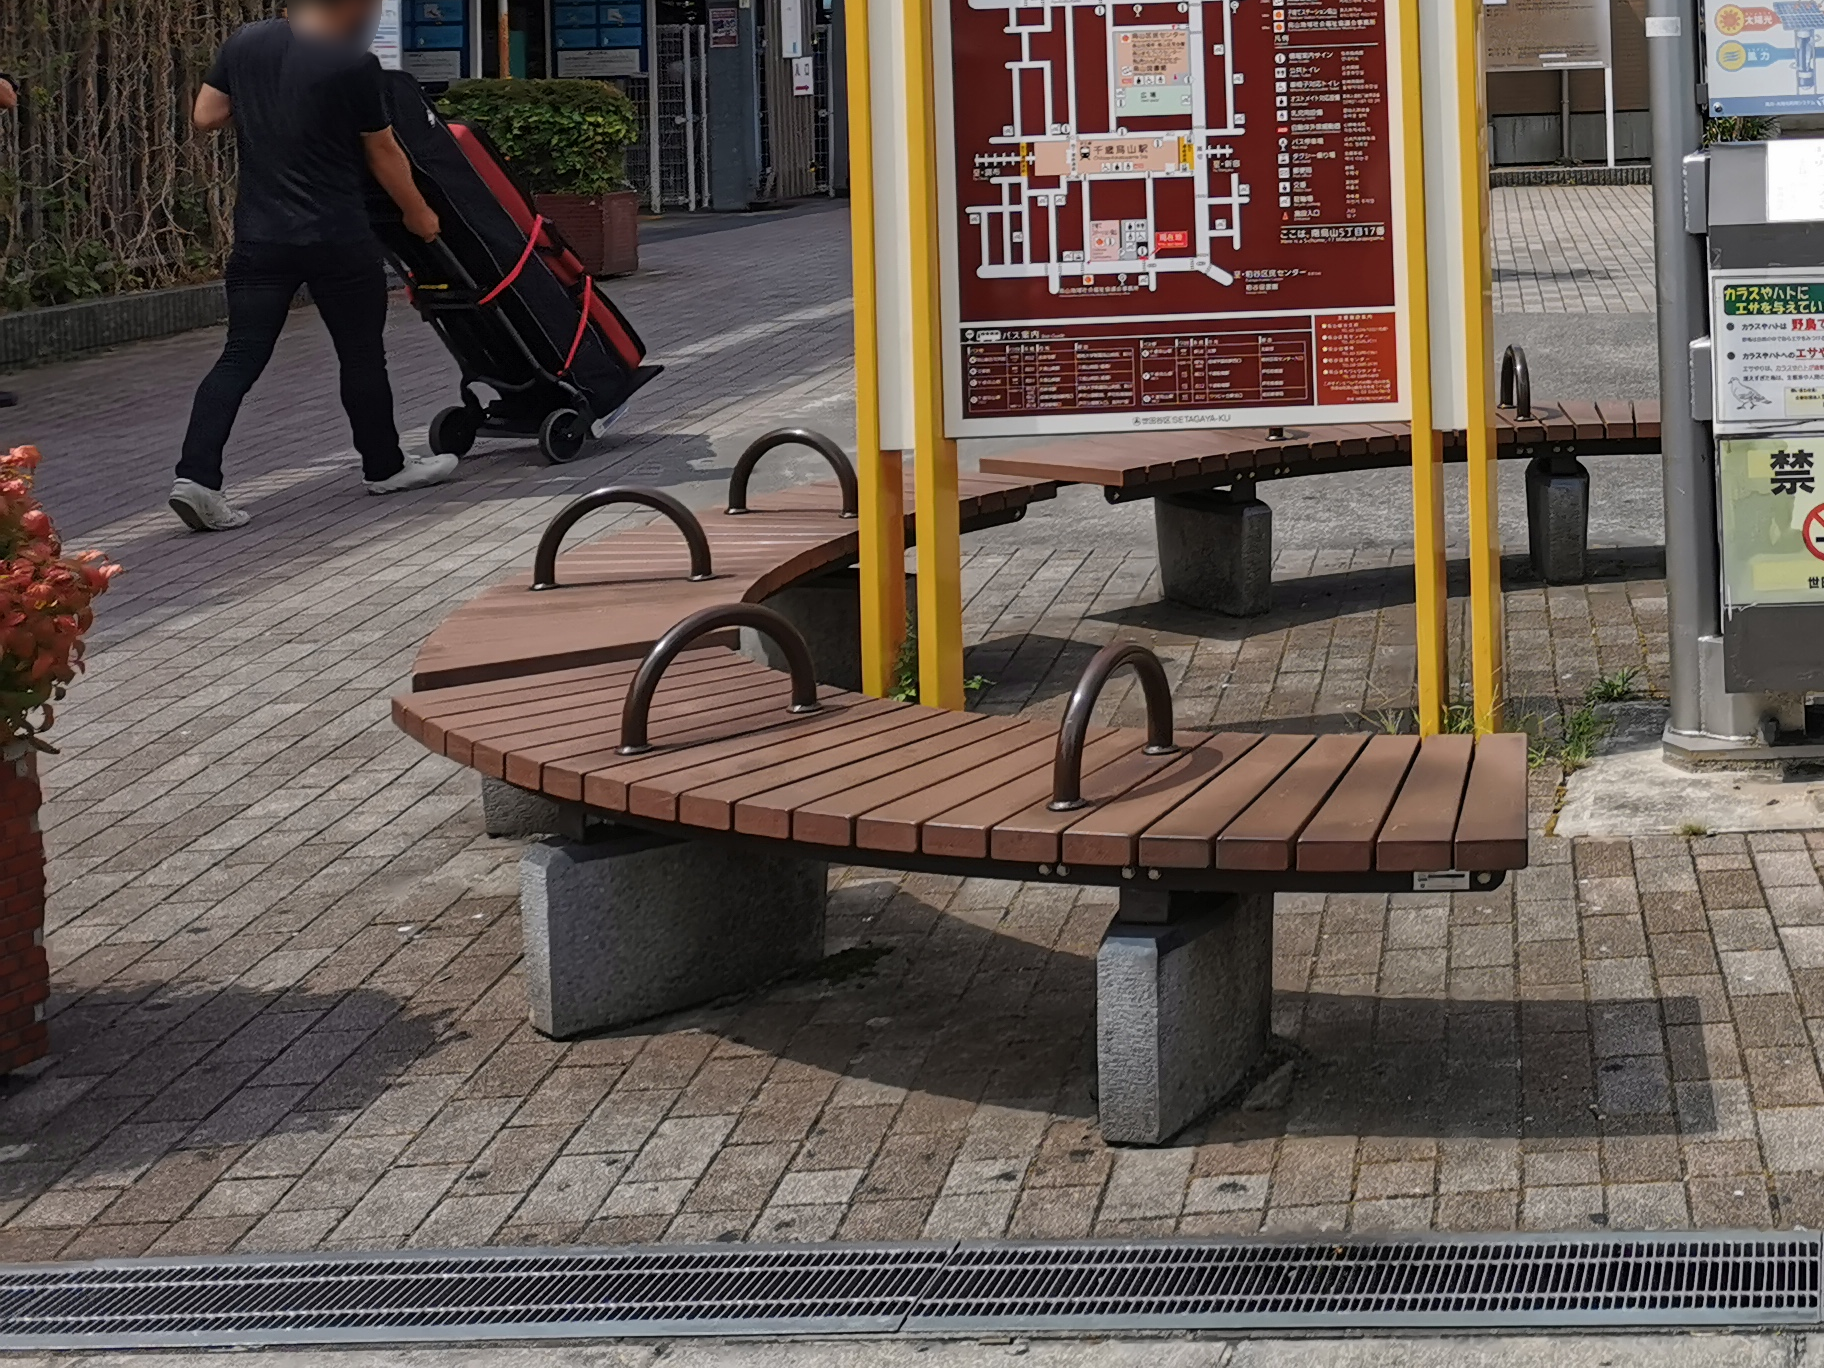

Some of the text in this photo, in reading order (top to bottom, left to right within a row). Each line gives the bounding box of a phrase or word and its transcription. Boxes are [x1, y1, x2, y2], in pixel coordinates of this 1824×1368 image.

[1745, 14, 1773, 25] 太陽光
[1093, 143, 1149, 154] 千歳烏山駅
[1724, 286, 1809, 301] カラスやハトに
